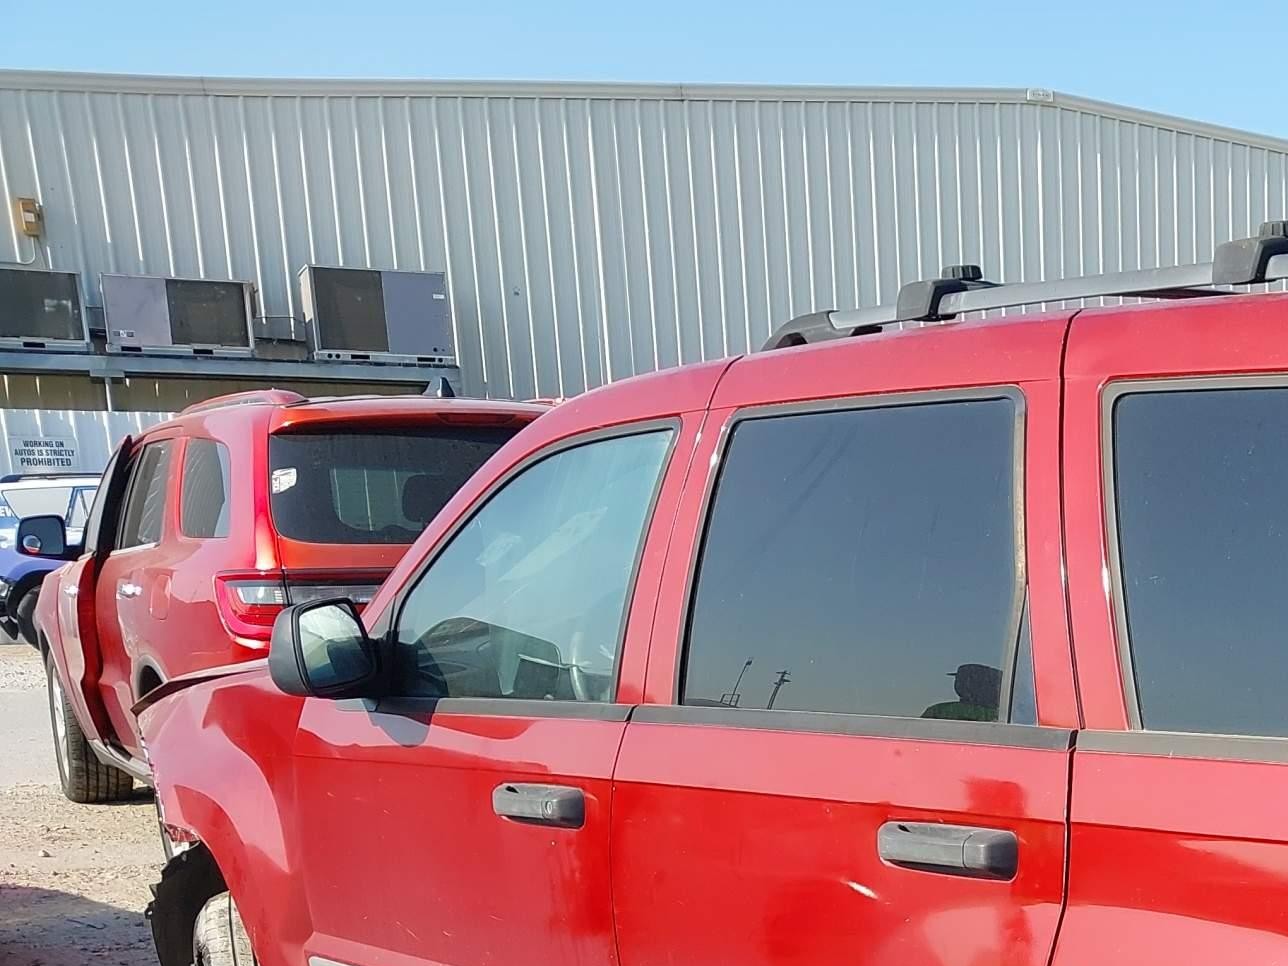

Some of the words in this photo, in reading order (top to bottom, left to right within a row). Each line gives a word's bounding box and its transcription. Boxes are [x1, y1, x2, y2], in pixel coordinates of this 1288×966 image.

[23, 440, 54, 448] WORKING
[45, 449, 75, 457] STRICTLY
[20, 457, 72, 467] PROHIBITED
